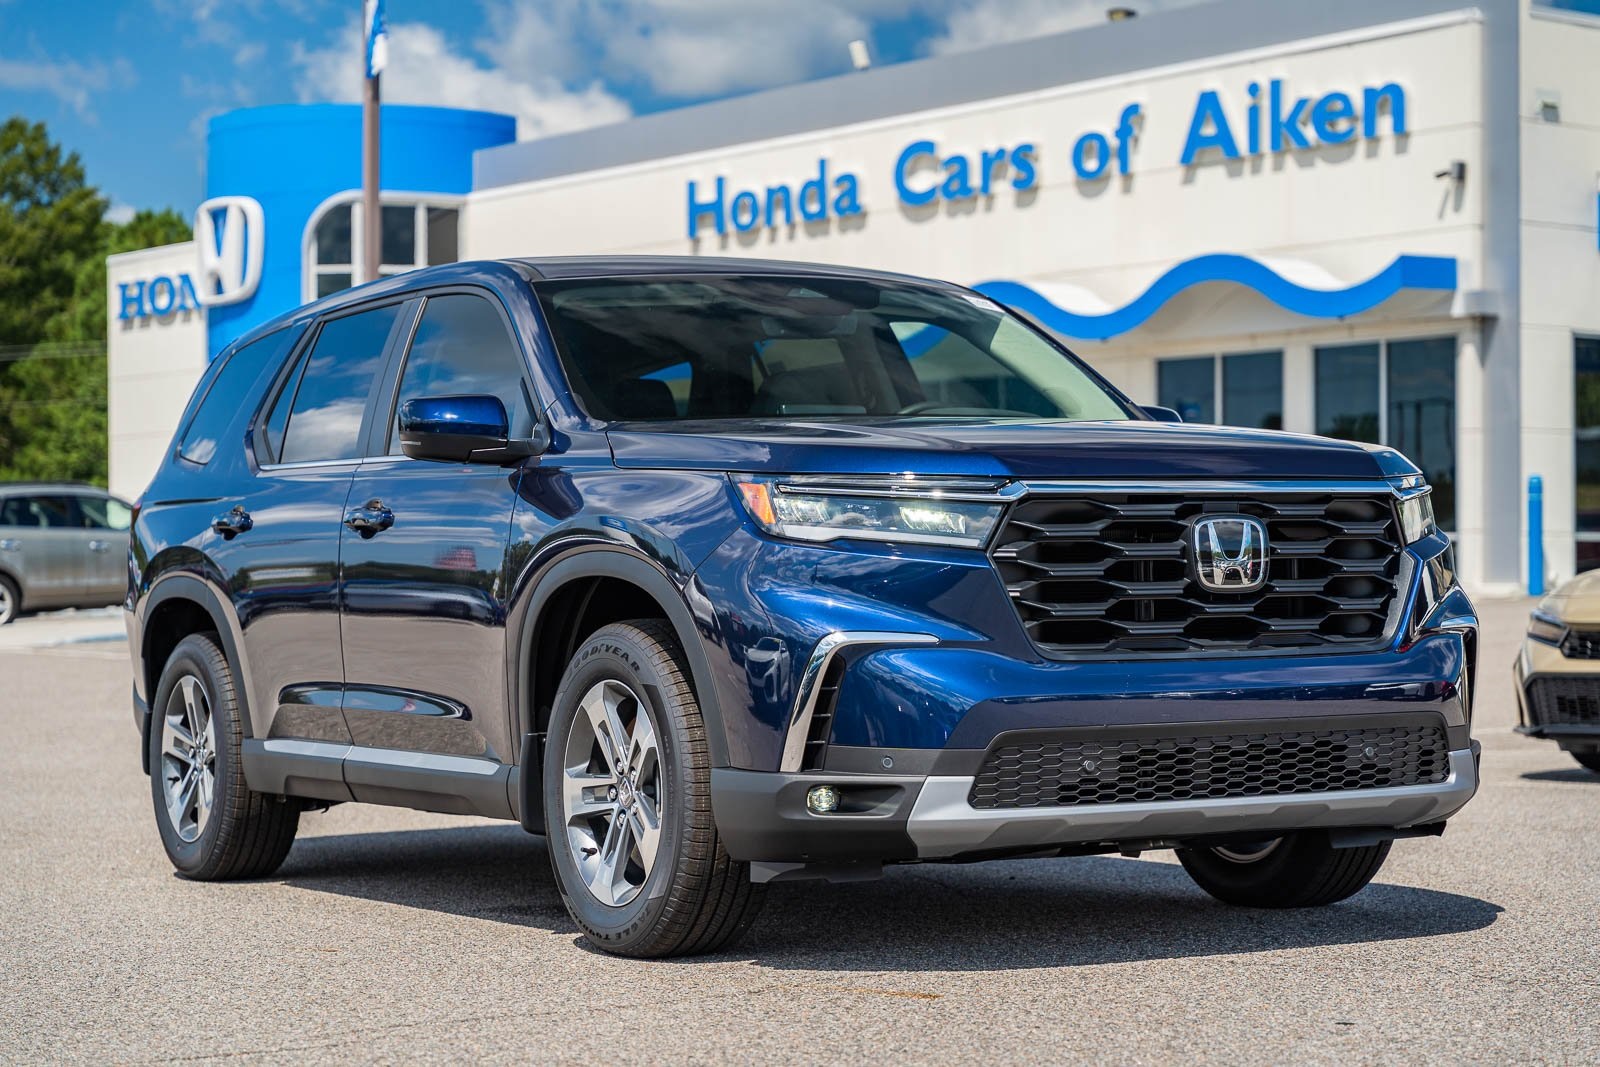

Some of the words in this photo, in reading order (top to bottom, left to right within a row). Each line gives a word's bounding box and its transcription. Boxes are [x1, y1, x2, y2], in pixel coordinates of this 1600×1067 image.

[687, 157, 863, 240] Honda
[894, 140, 1037, 207] Cars
[1072, 103, 1141, 180] of
[1179, 78, 1408, 166] Aiken
